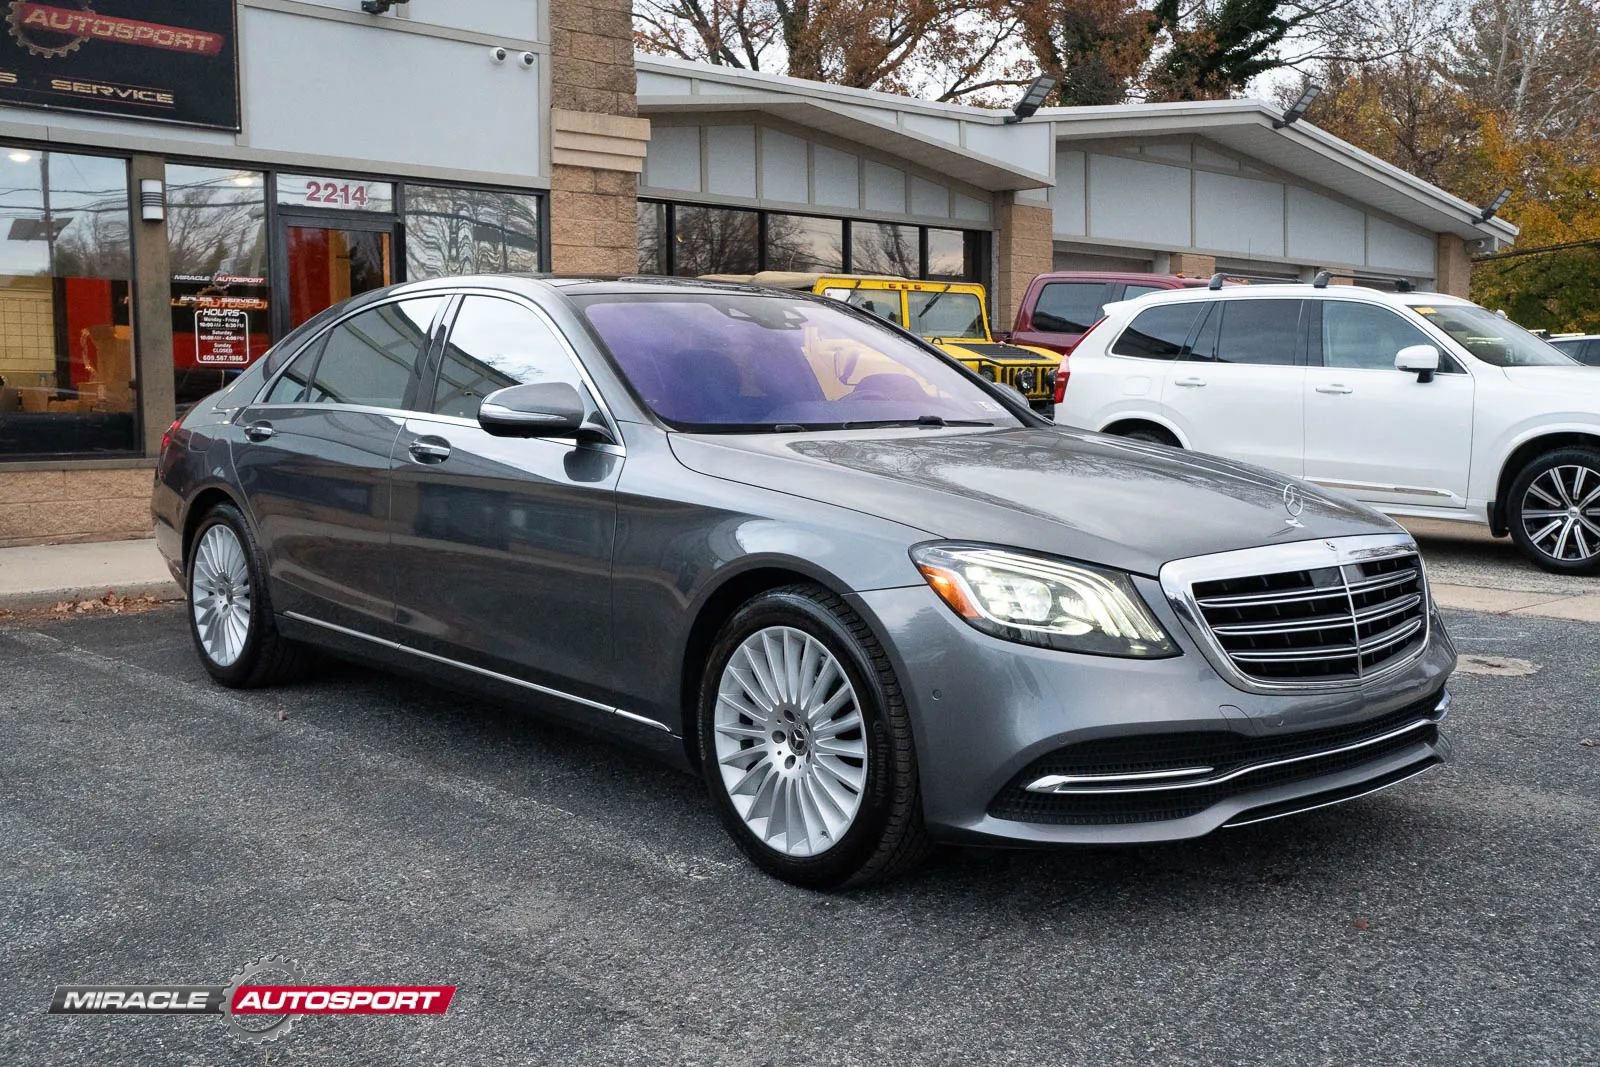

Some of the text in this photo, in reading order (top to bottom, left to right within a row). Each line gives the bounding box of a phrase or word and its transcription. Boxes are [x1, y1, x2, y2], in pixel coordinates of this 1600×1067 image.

[24, 8, 213, 51] AUTOSPORT
[51, 79, 175, 104] SERVICE
[306, 181, 367, 206] 2214
[215, 276, 264, 284] AUTOSPORT
[203, 309, 240, 317] HOURS
